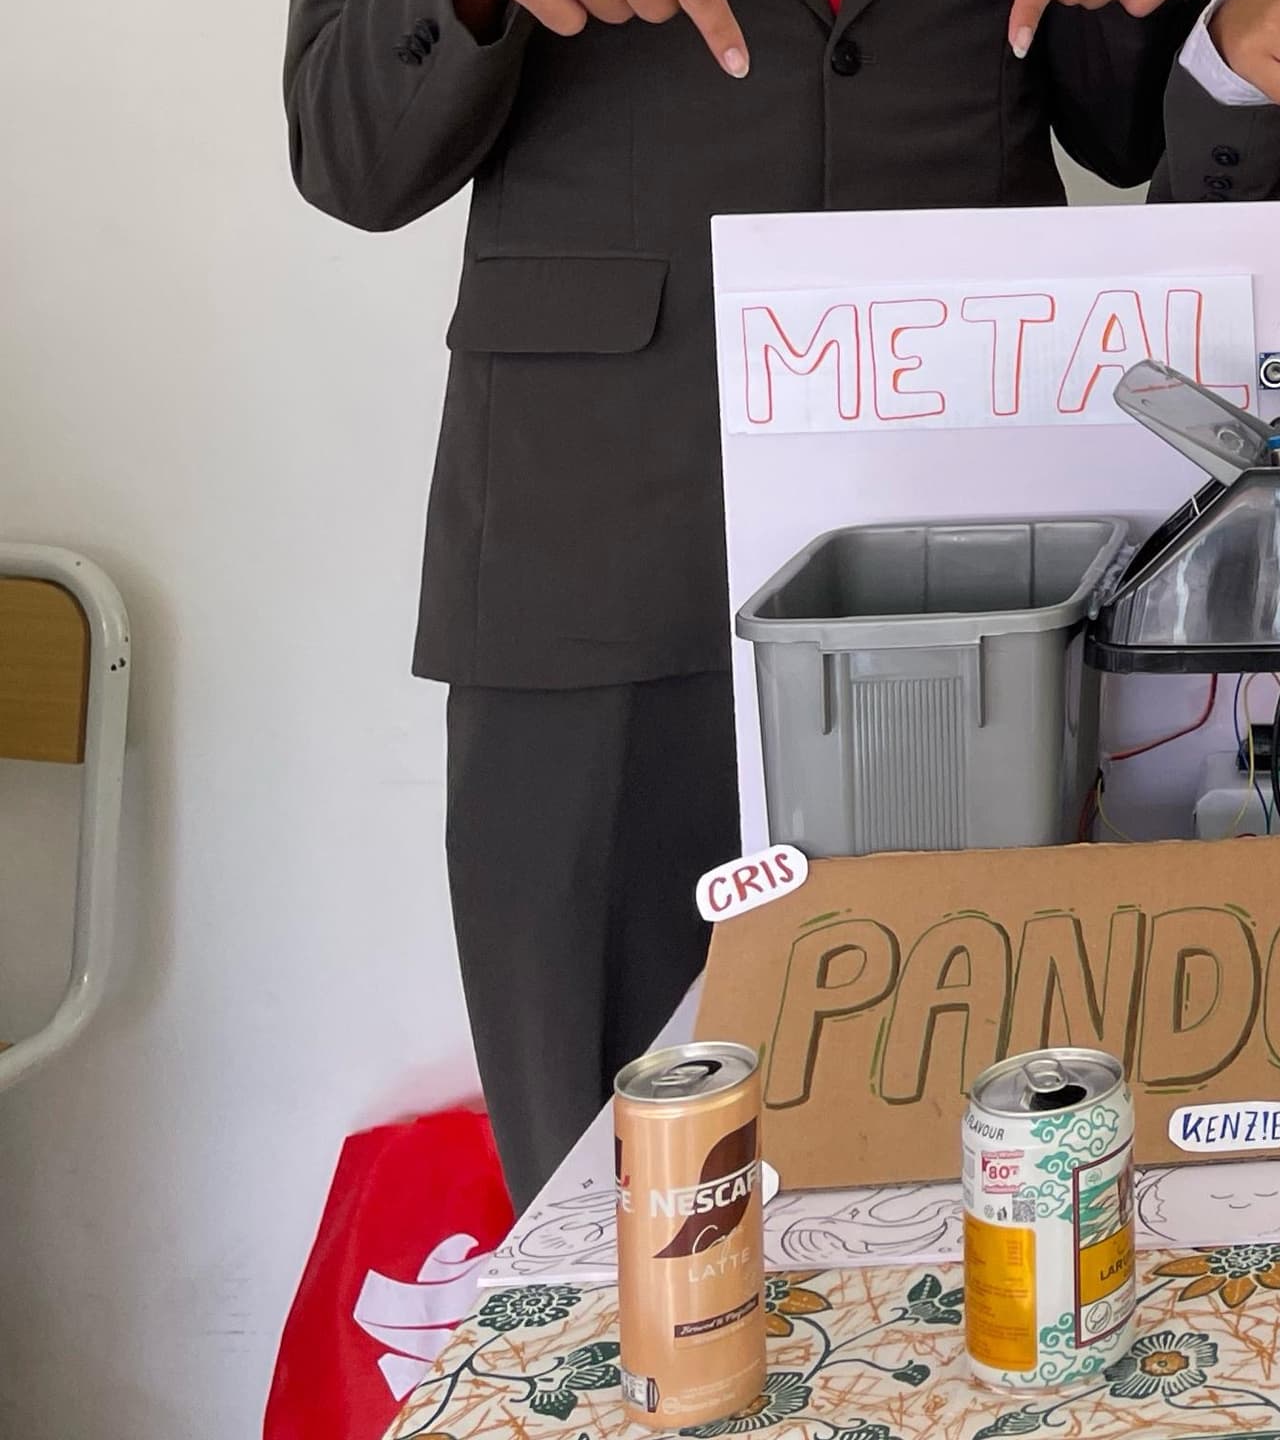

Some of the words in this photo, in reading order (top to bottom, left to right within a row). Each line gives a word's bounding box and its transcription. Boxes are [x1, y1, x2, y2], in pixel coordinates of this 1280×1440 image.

[741, 288, 1250, 424] METAL
[708, 853, 794, 912] CRIS
[649, 1164, 760, 1219] NESCAF
[688, 1247, 751, 1283] LATTE
